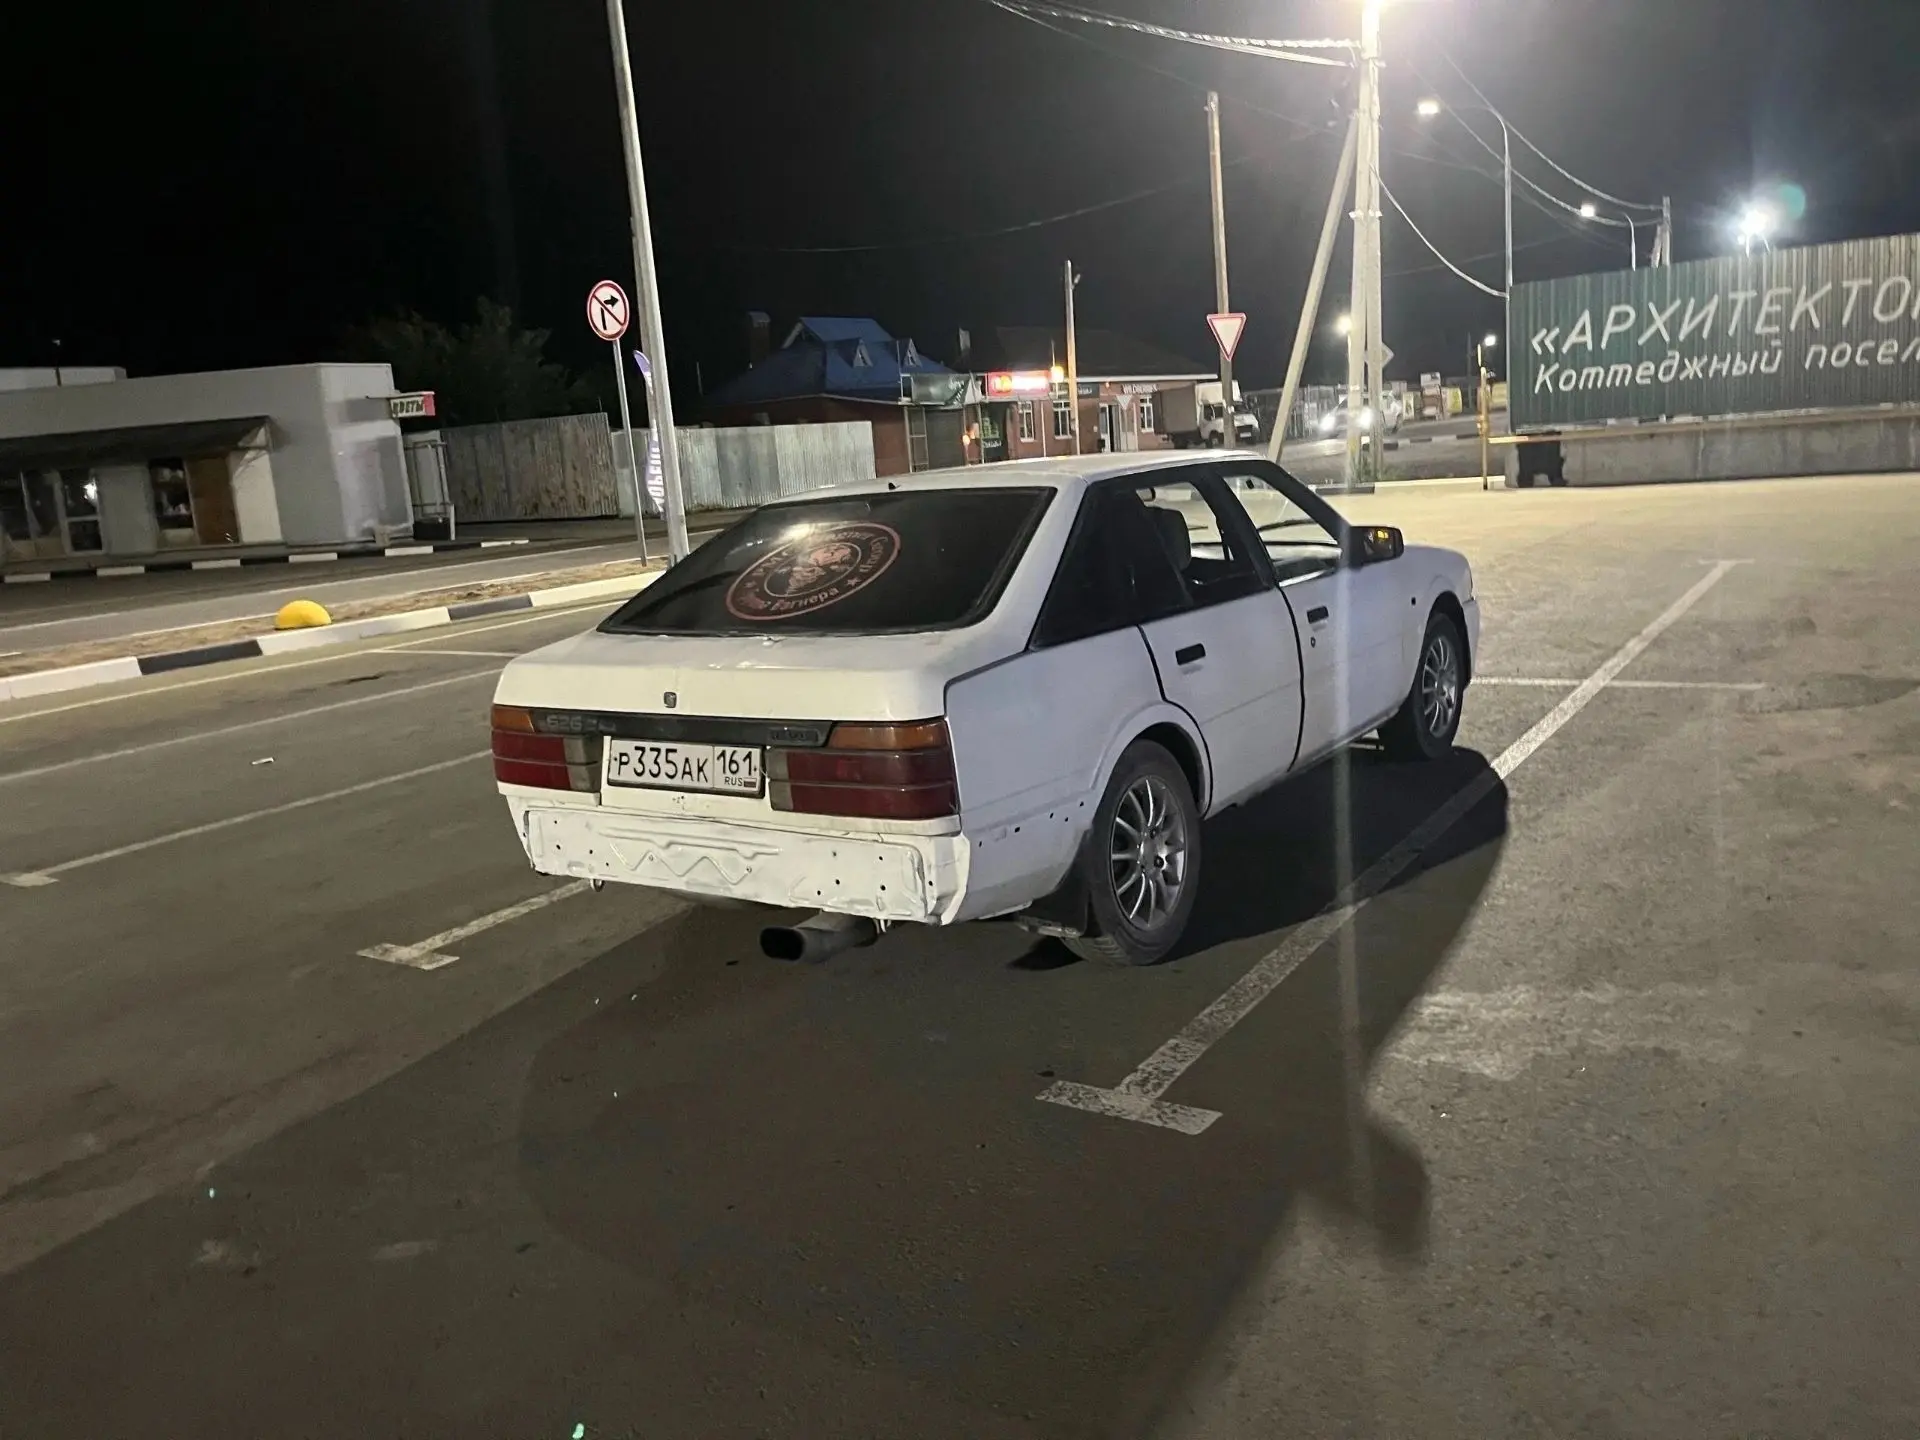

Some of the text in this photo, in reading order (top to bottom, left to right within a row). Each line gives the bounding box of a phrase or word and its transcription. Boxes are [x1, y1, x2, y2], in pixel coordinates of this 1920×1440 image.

[1531, 275, 1920, 355] «АРХИТЕКТО
[1534, 339, 1783, 394] Коттеджный
[617, 745, 753, 784] Р335АК 161
[723, 776, 744, 787] RUS
